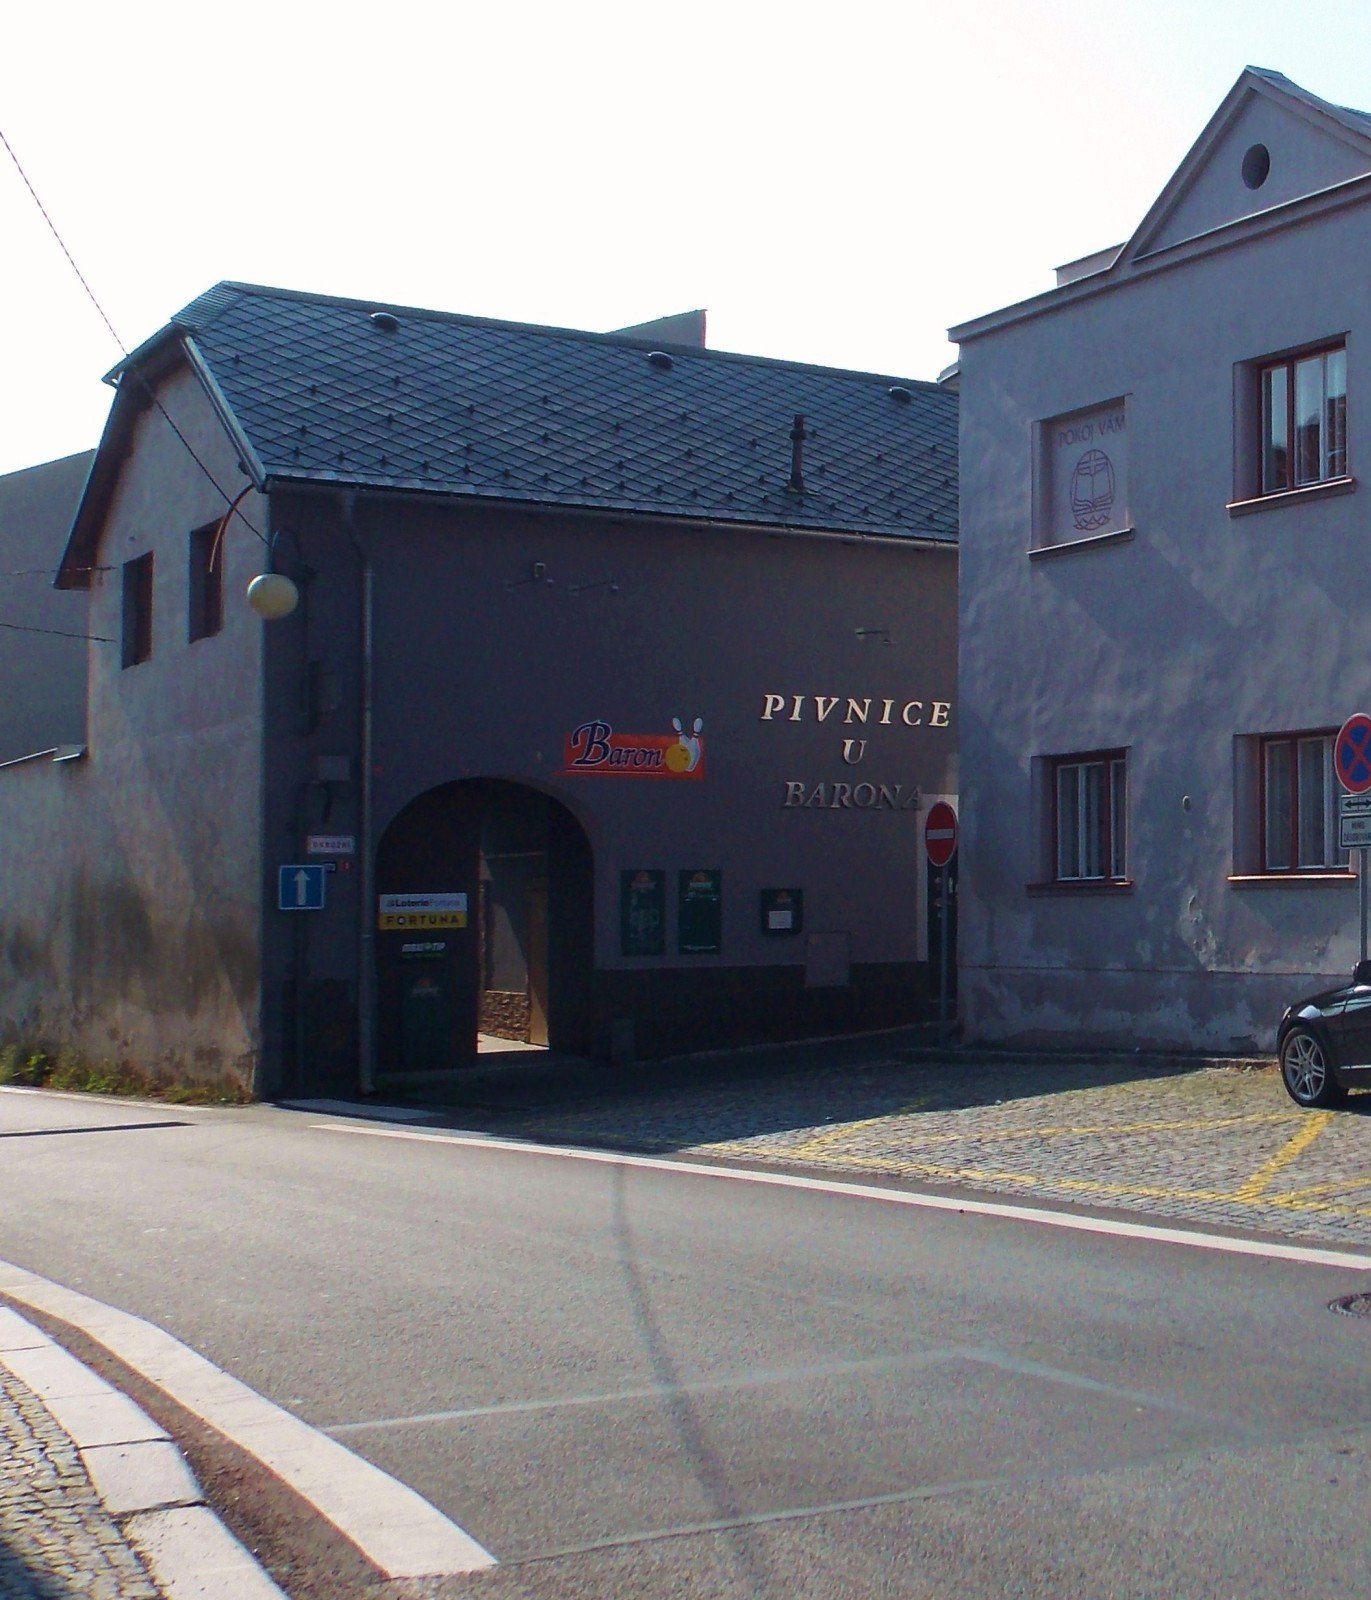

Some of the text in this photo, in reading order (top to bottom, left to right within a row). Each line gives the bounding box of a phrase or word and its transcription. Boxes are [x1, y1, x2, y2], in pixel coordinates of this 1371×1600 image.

[1058, 424, 1093, 447] POKOJ
[760, 694, 952, 728] PIVNICE
[571, 719, 663, 768] Baron
[842, 739, 867, 765] U
[784, 781, 924, 810] BARONA
[386, 915, 460, 925] FORTUNA
